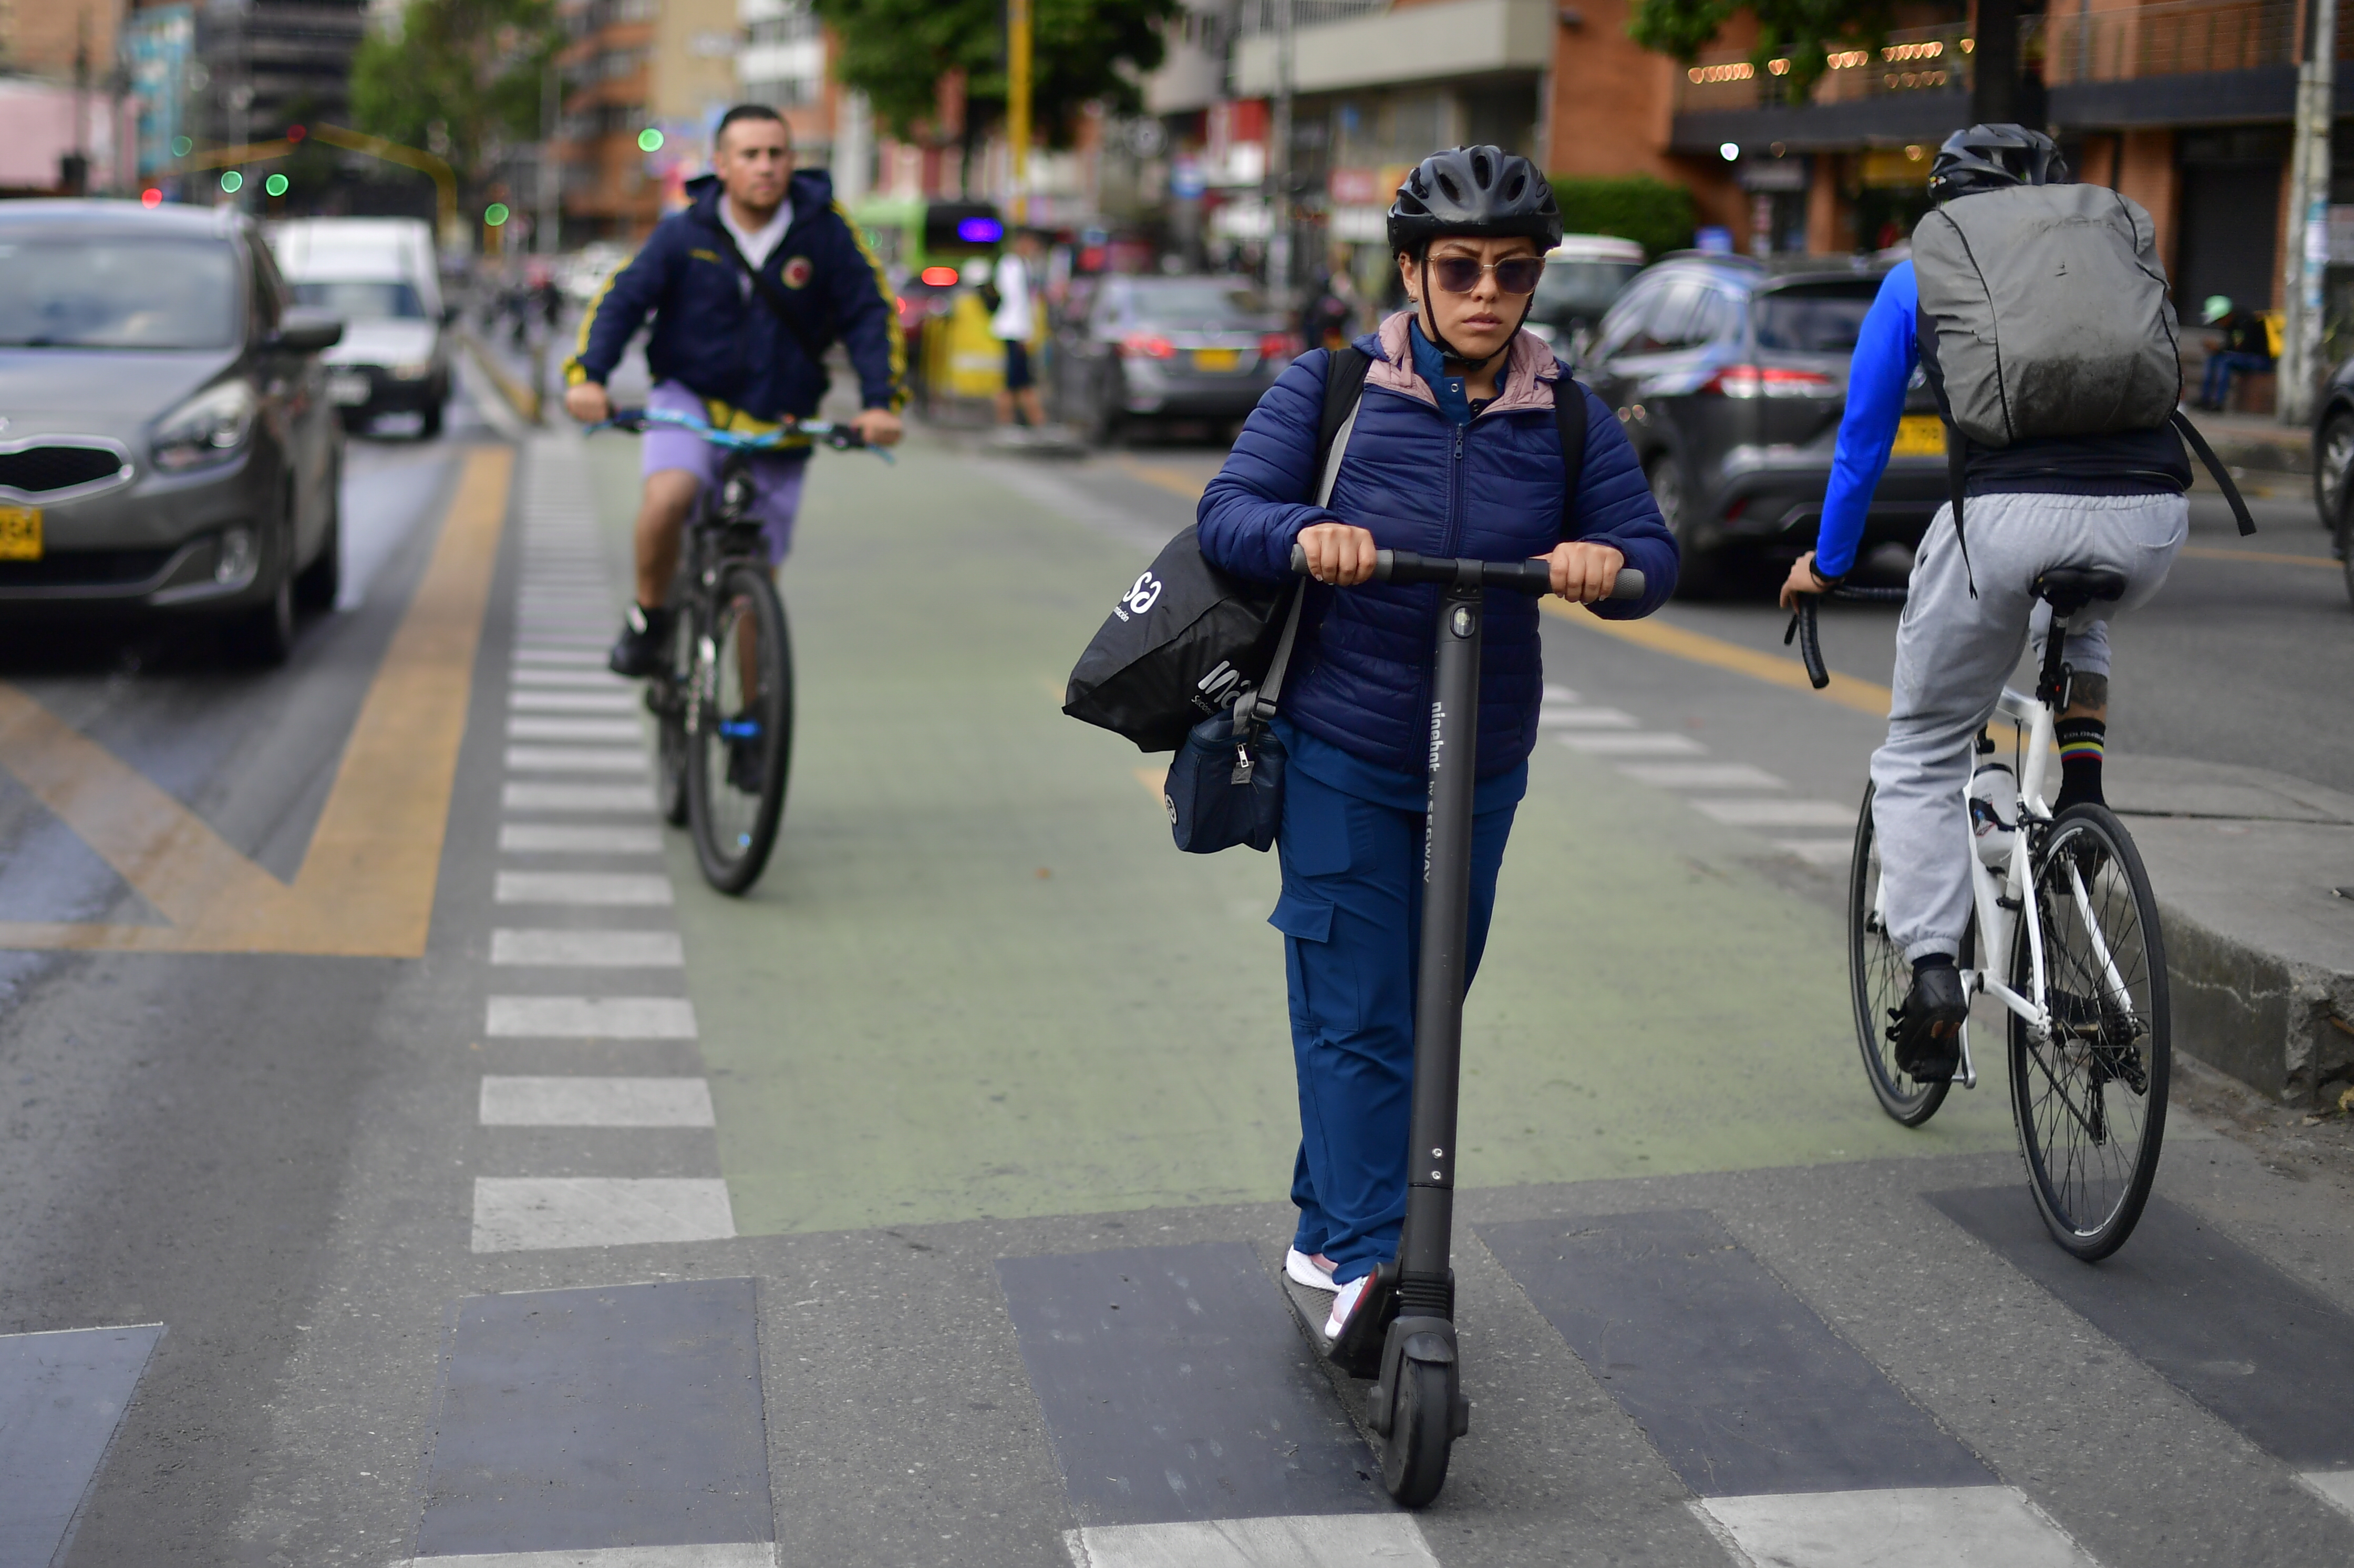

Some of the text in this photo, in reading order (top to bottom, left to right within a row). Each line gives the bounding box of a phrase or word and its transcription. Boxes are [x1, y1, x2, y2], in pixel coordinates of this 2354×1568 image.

[1423, 702, 1446, 883] ninebot by SEGWAY
